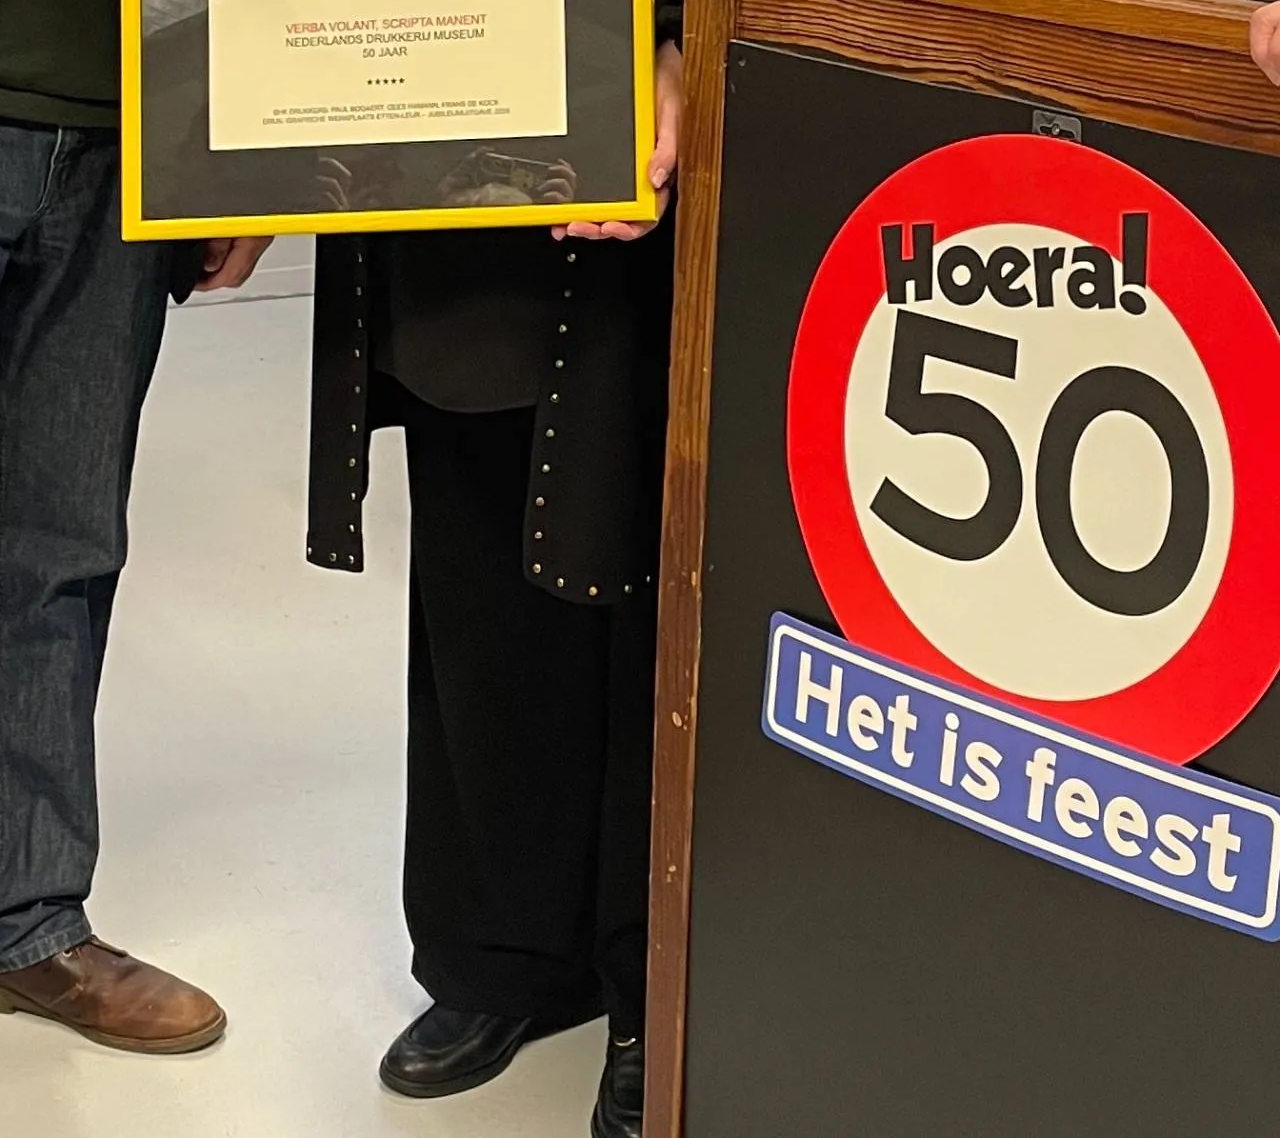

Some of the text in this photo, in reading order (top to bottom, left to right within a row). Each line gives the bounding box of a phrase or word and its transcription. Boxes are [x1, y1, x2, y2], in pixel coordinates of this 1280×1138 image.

[285, 28, 485, 48] NEDERLANDS DRUKKERIJ MUSEUM
[286, 14, 487, 34] VERBA VOLANT, SCRIPTA MANENT
[362, 46, 408, 58] 50 JAAR
[880, 212, 1151, 316] Hoera!
[869, 309, 1210, 617] 50
[794, 651, 1242, 893] Het is feest
